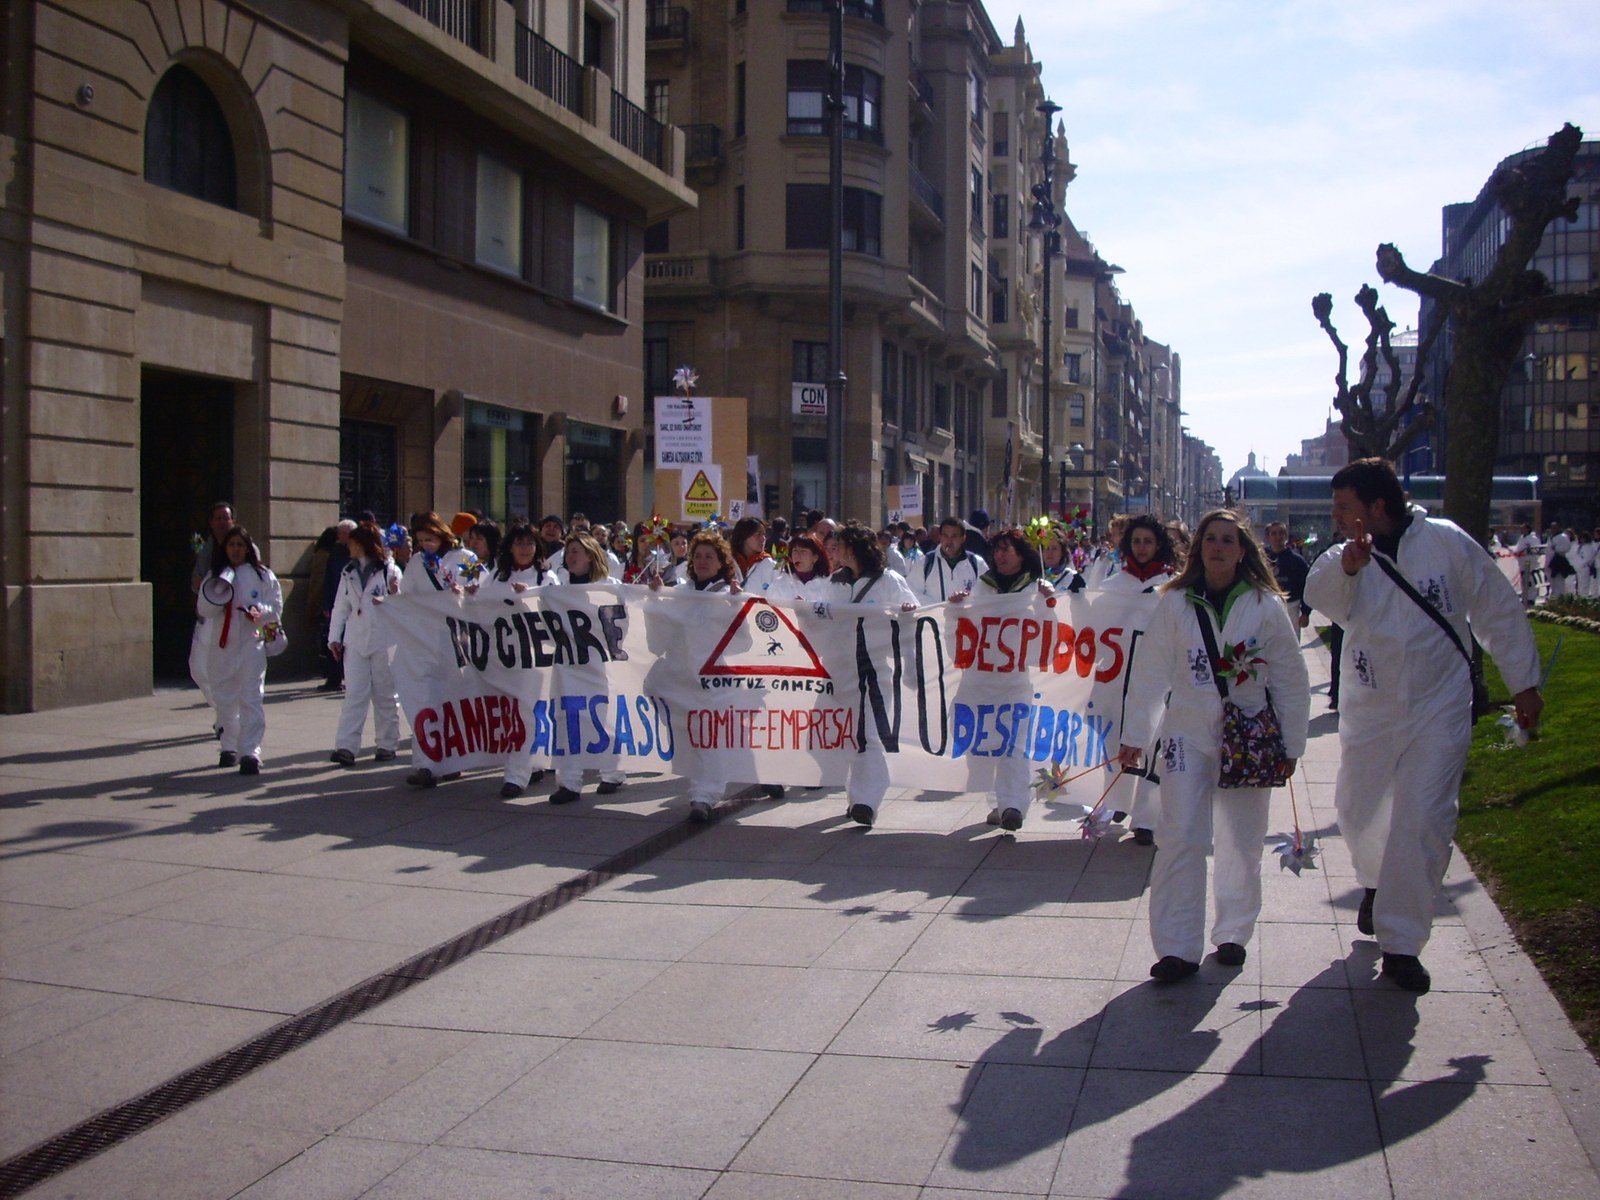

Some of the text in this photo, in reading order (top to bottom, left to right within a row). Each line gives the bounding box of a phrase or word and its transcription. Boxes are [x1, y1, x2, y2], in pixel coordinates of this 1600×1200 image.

[801, 387, 824, 404] CDN
[446, 599, 629, 671] NO CIERRE
[701, 676, 834, 695] KONTUZ GAMESA
[857, 597, 1123, 756] NO DESPIDOS
[414, 694, 674, 762] GAMESA ALTSASU
[687, 705, 857, 750] COMITE-EMPRESA
[952, 692, 1114, 772] DESPIDORIK
